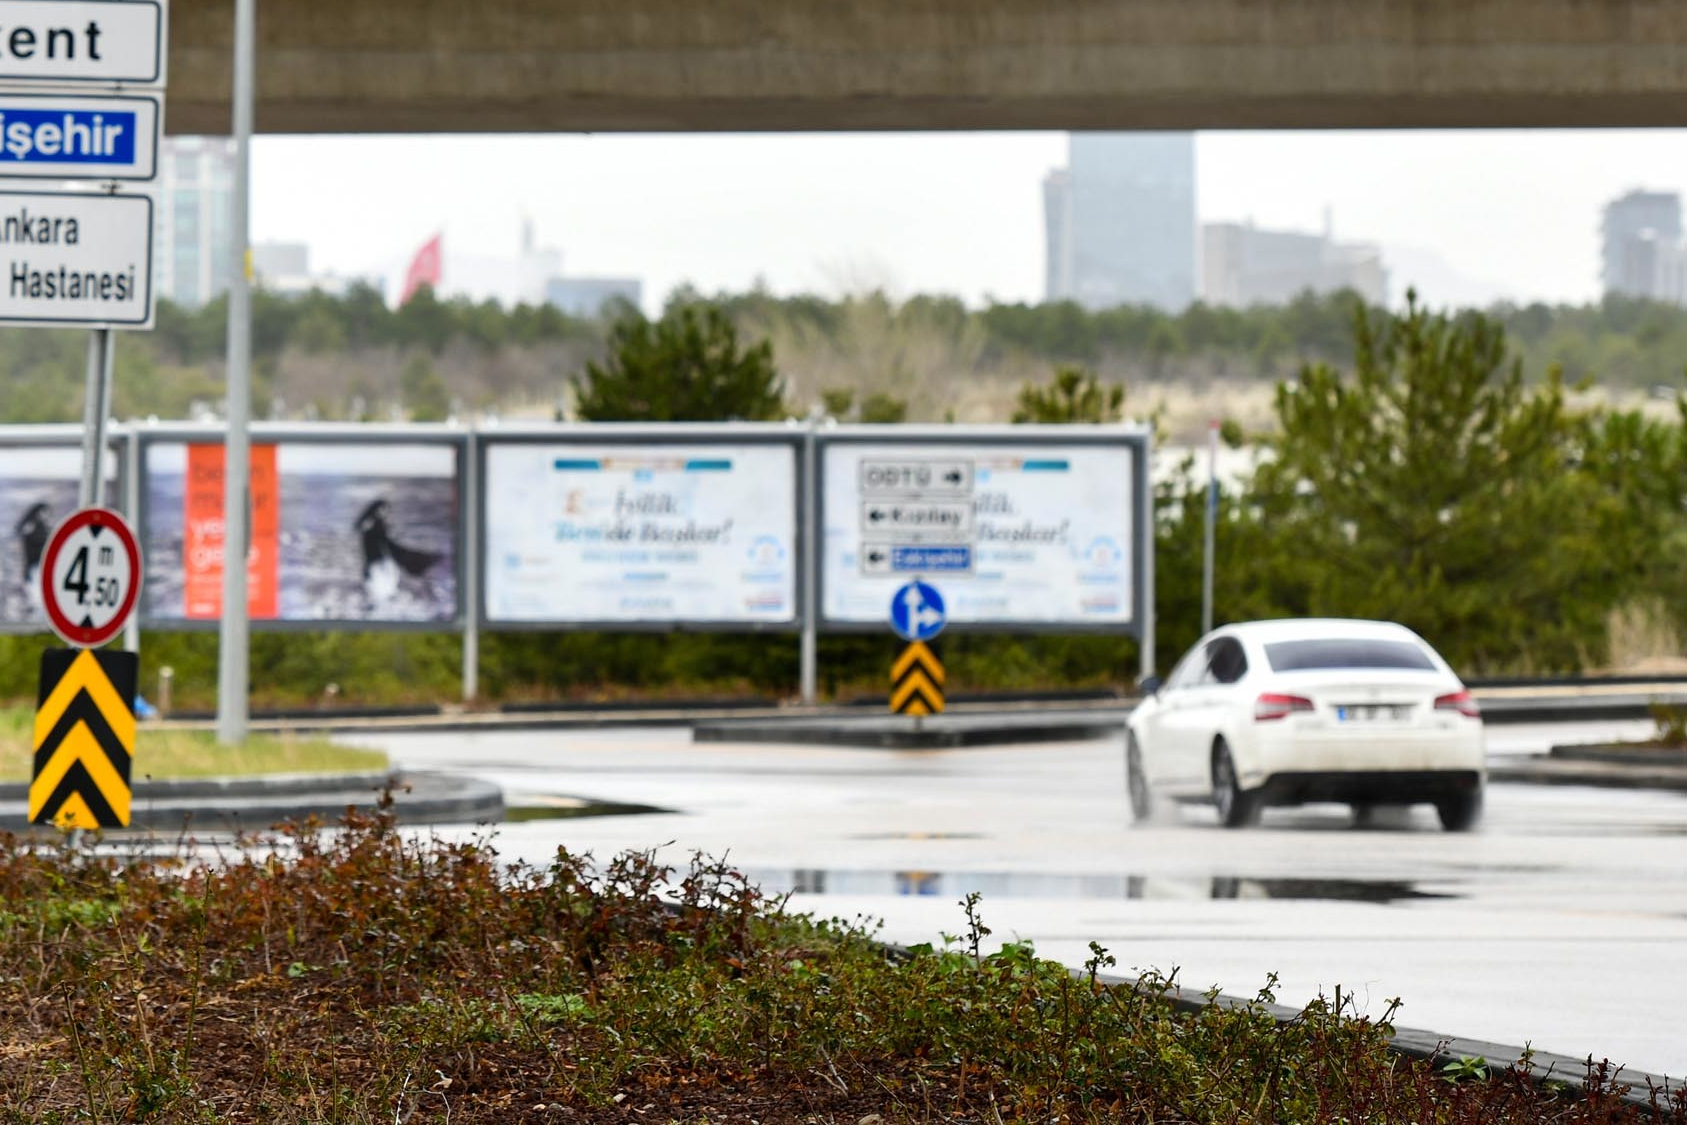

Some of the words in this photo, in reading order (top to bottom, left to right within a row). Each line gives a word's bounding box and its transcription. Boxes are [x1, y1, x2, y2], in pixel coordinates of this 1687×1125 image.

[9, 261, 136, 302] Hastanesi
[62, 545, 89, 605] 4
[98, 546, 114, 566] m
